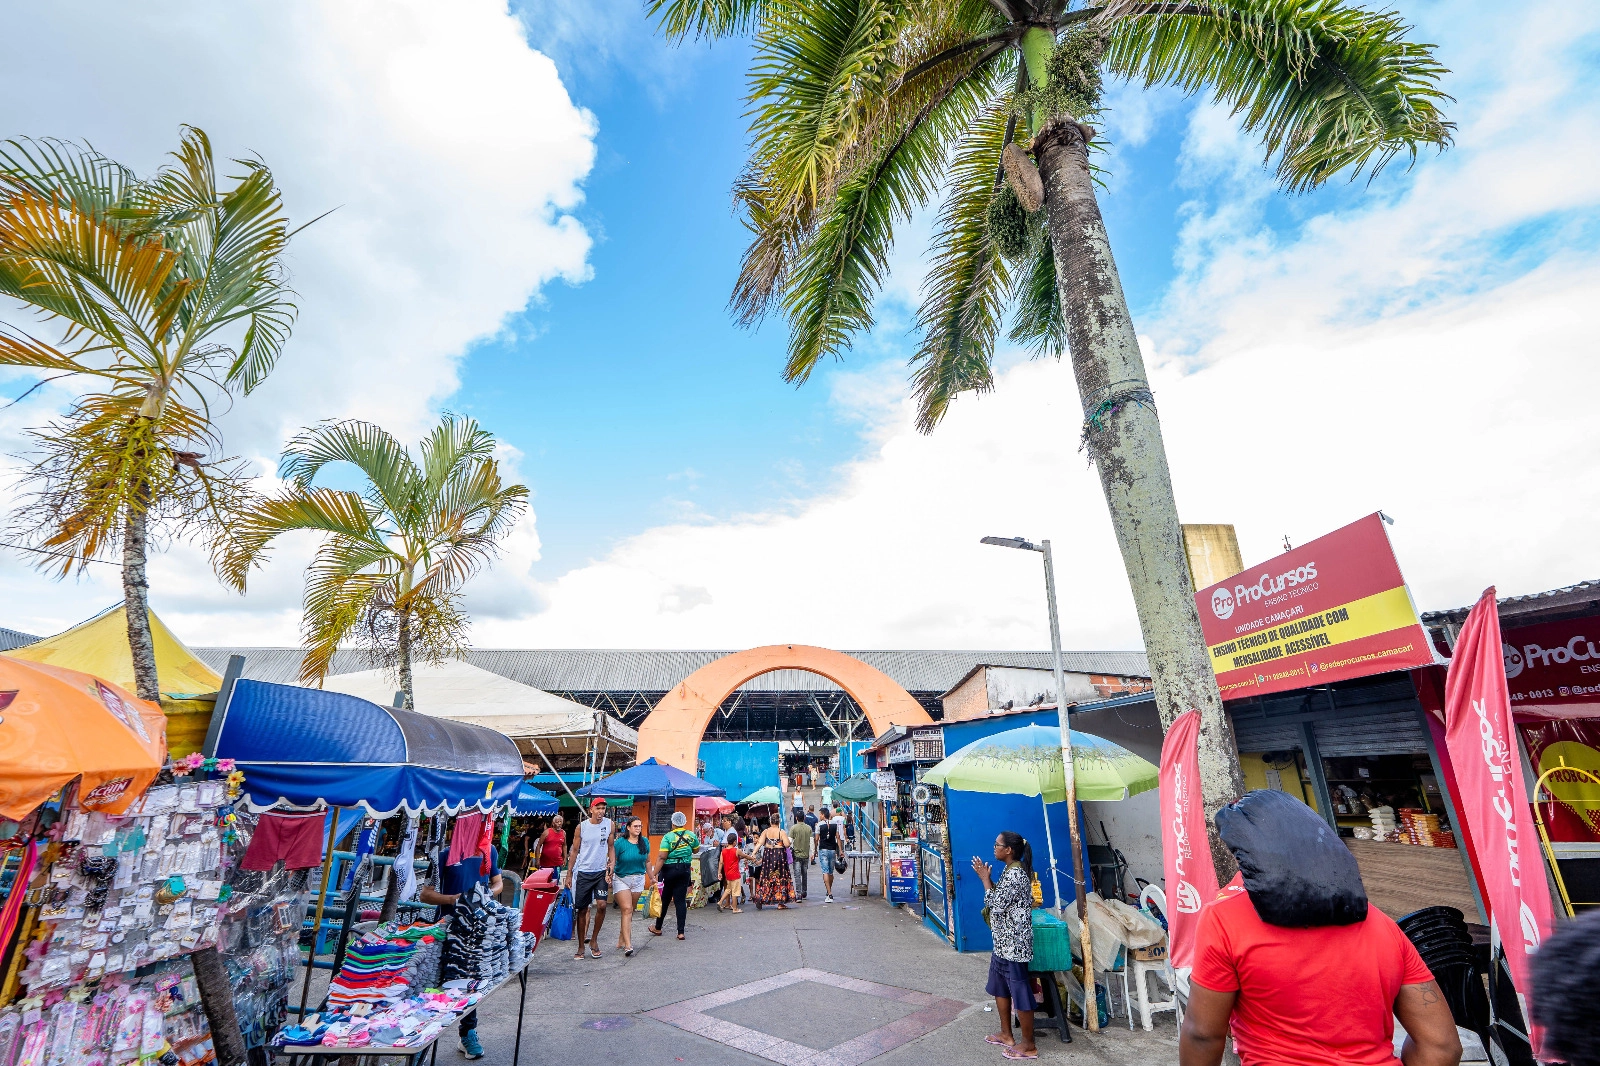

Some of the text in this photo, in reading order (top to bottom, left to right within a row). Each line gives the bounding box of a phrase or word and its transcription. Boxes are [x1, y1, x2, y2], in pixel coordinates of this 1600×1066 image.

[1234, 561, 1318, 607] ProCursos
[1214, 596, 1234, 612] Pro
[1264, 593, 1288, 608] ENSINO
[1212, 608, 1350, 658] ENSINO TÉCNICO DE QUALIDADE COM
[1234, 604, 1304, 634] UNIDADE CAMAÇARI
[1232, 632, 1331, 668] MENSALIDADE ACESSÍVEL
[88, 782, 128, 798] SCHIN
